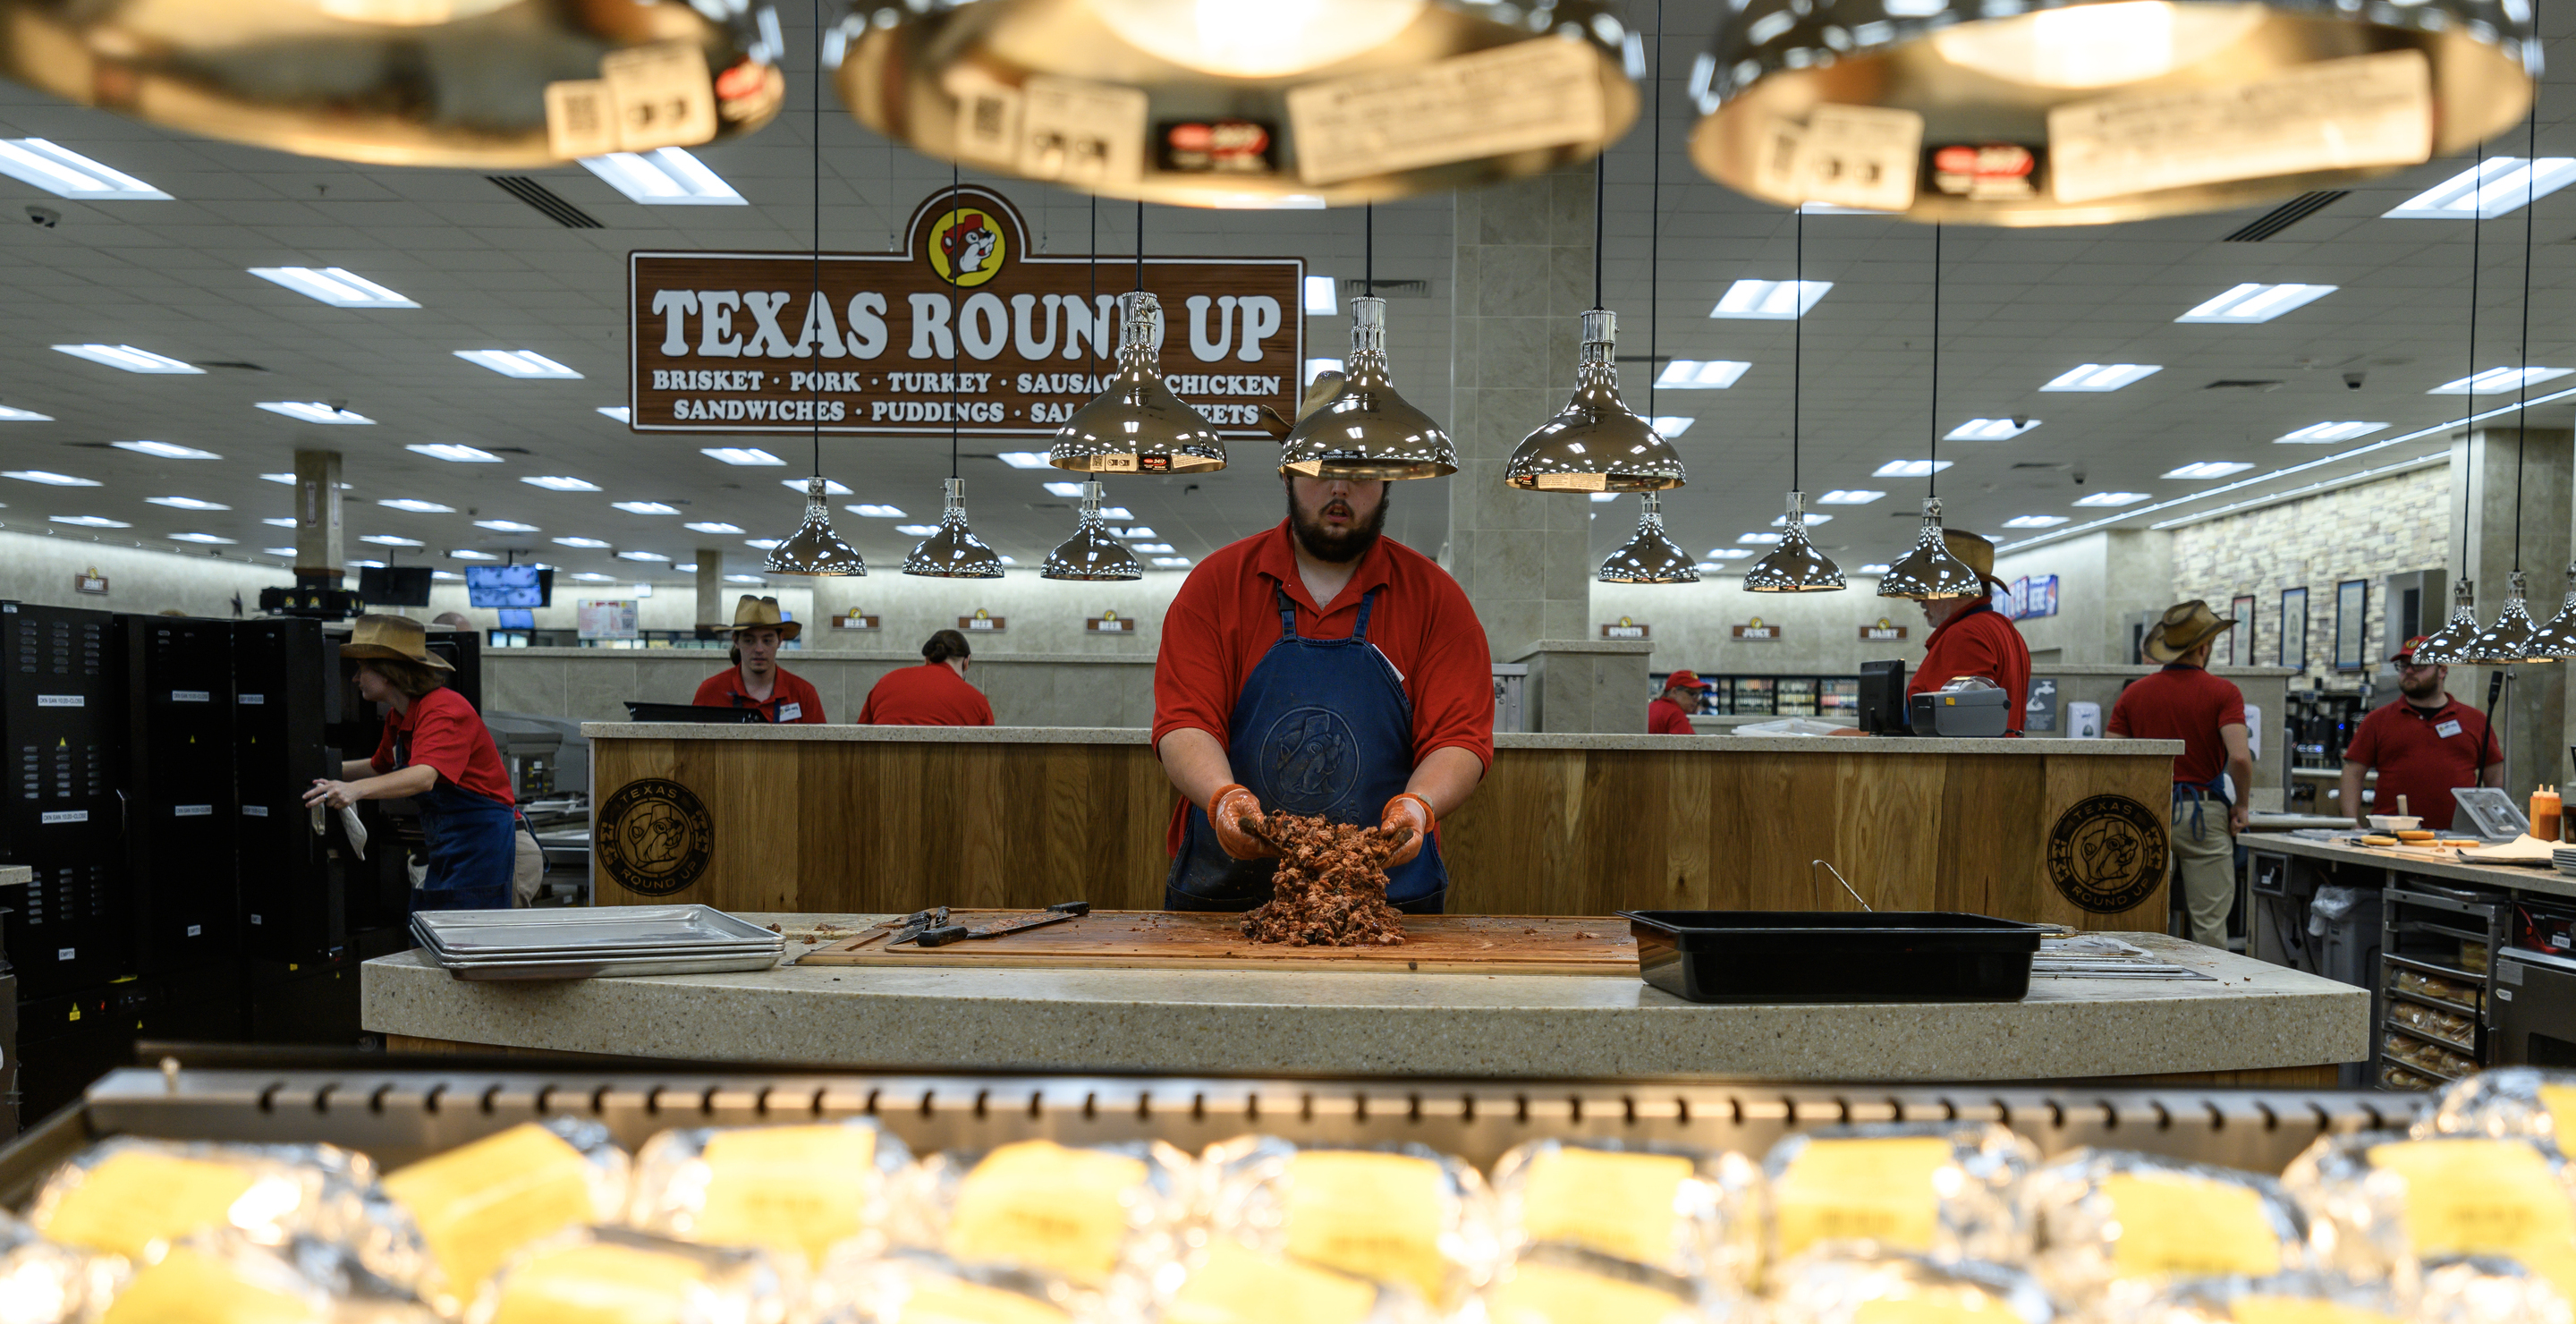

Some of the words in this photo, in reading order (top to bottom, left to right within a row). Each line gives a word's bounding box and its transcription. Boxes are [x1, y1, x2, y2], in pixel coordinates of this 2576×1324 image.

[652, 288, 889, 361] TEXAS
[1185, 294, 1283, 362] UP
[652, 369, 764, 392] BRISKET
[790, 370, 861, 392] PORK
[887, 371, 992, 393] TURKEY
[1164, 374, 1281, 395] CHICKEN
[674, 399, 845, 421] SANDWICHES
[871, 401, 1004, 423] PUDDINGS
[1191, 404, 1259, 425] EETS
[1608, 627, 1643, 638] SPORTS
[1742, 628, 1771, 638] JUICE
[1868, 628, 1900, 639] DAIRY
[620, 785, 678, 803] TEXAS
[2073, 802, 2132, 820] TEXAS
[621, 869, 675, 889] ROUND
[680, 861, 696, 879] UP
[2072, 886, 2127, 906] ROUND
[2132, 878, 2148, 896] UP
